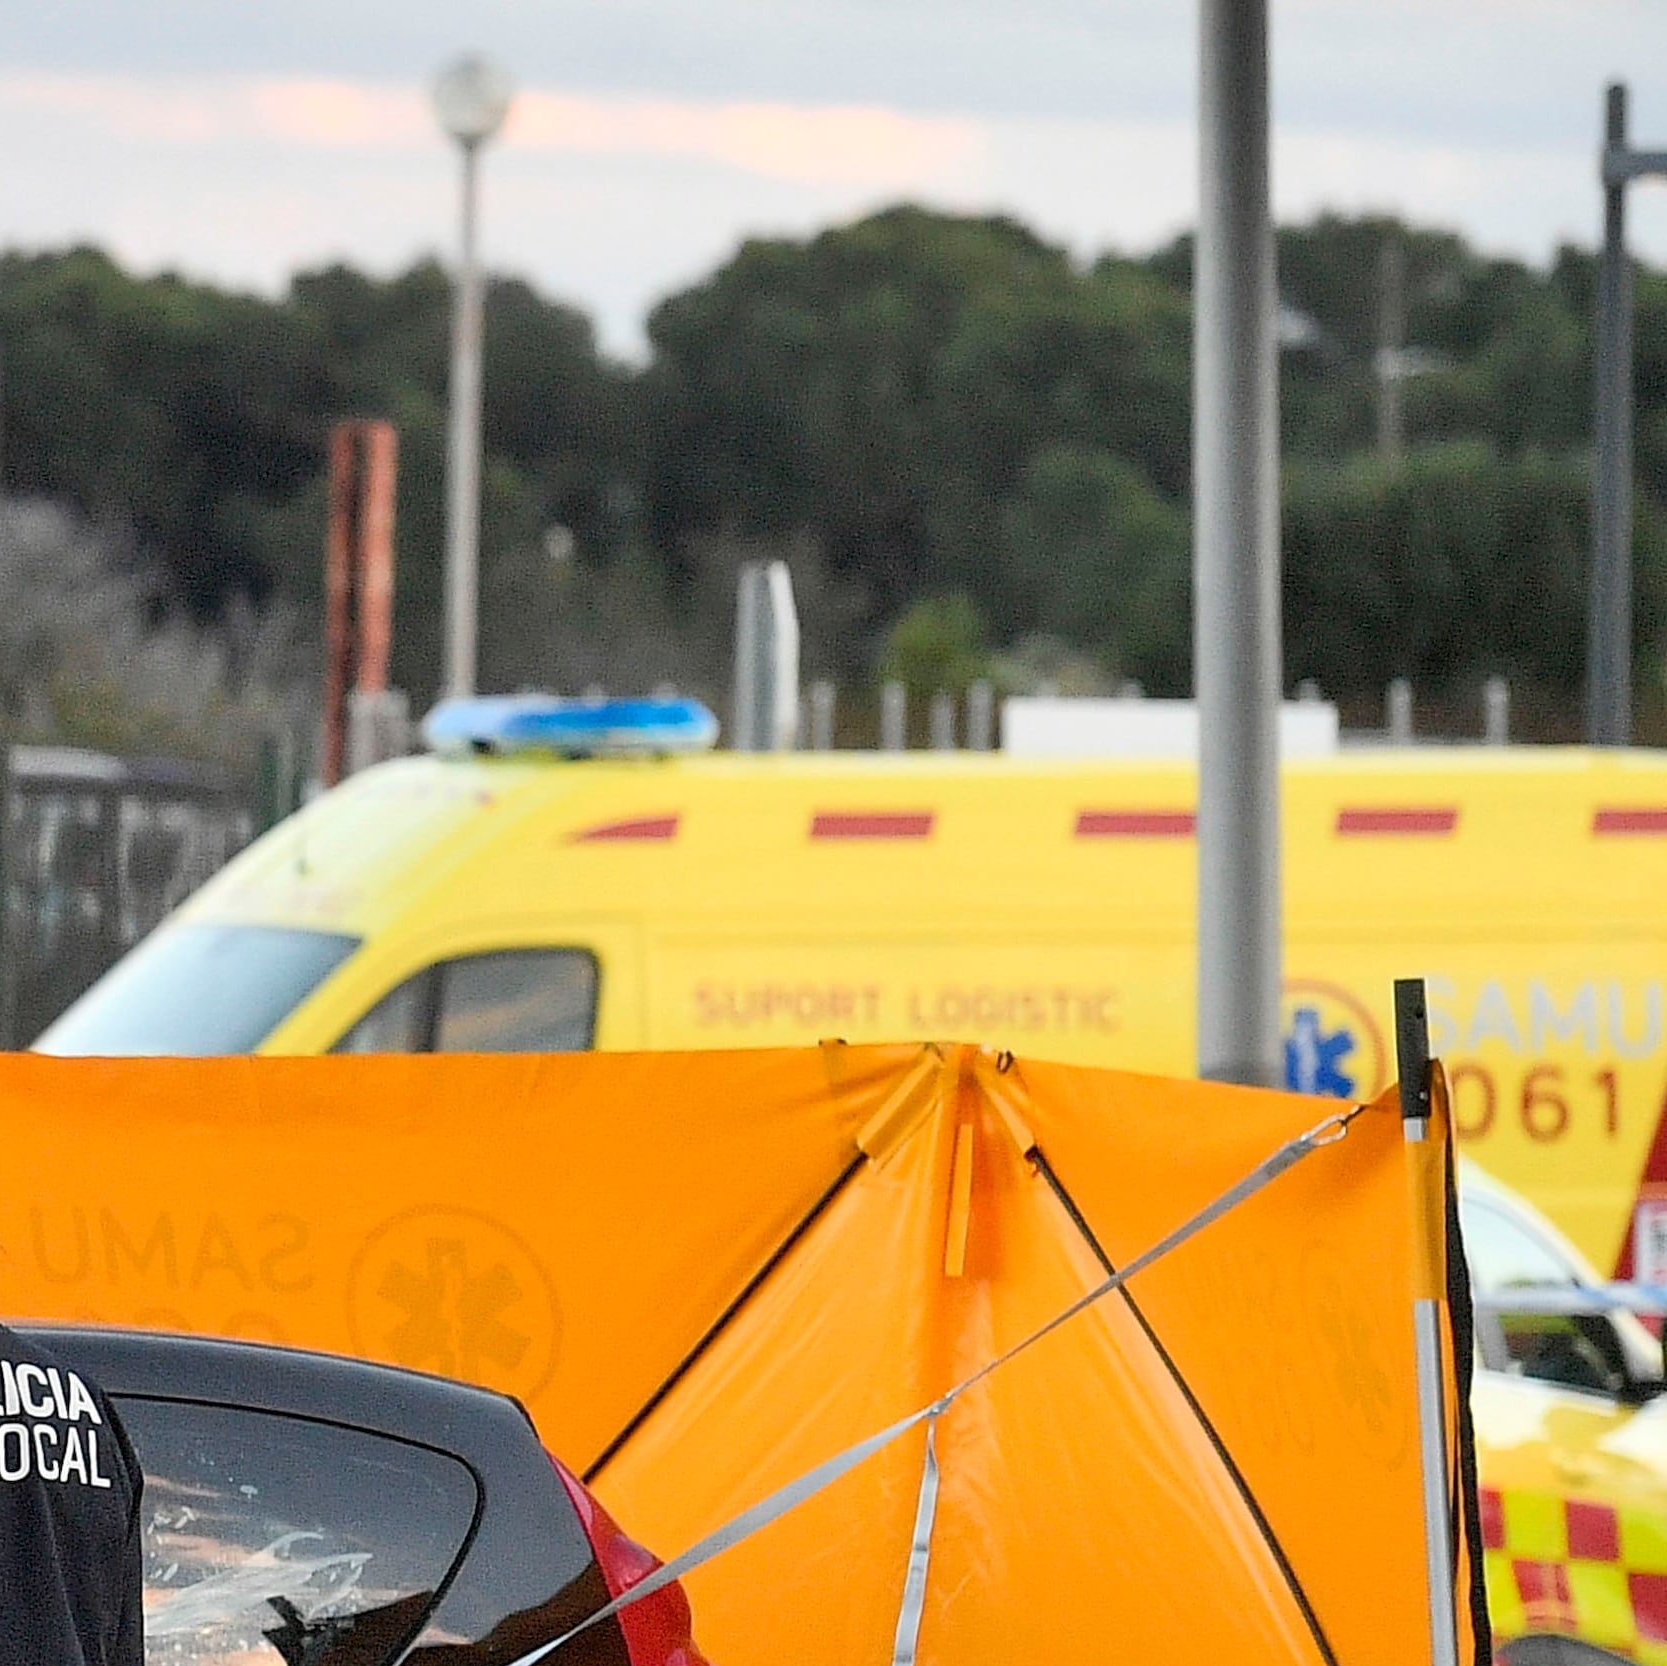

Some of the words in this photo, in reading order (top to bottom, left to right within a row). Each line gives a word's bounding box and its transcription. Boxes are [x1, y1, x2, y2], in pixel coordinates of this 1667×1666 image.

[695, 983, 881, 1030] SUPORT
[907, 985, 1121, 1033] LOGISTIC
[1425, 974, 1663, 1060] SAMU
[1451, 1061, 1621, 1144] 061
